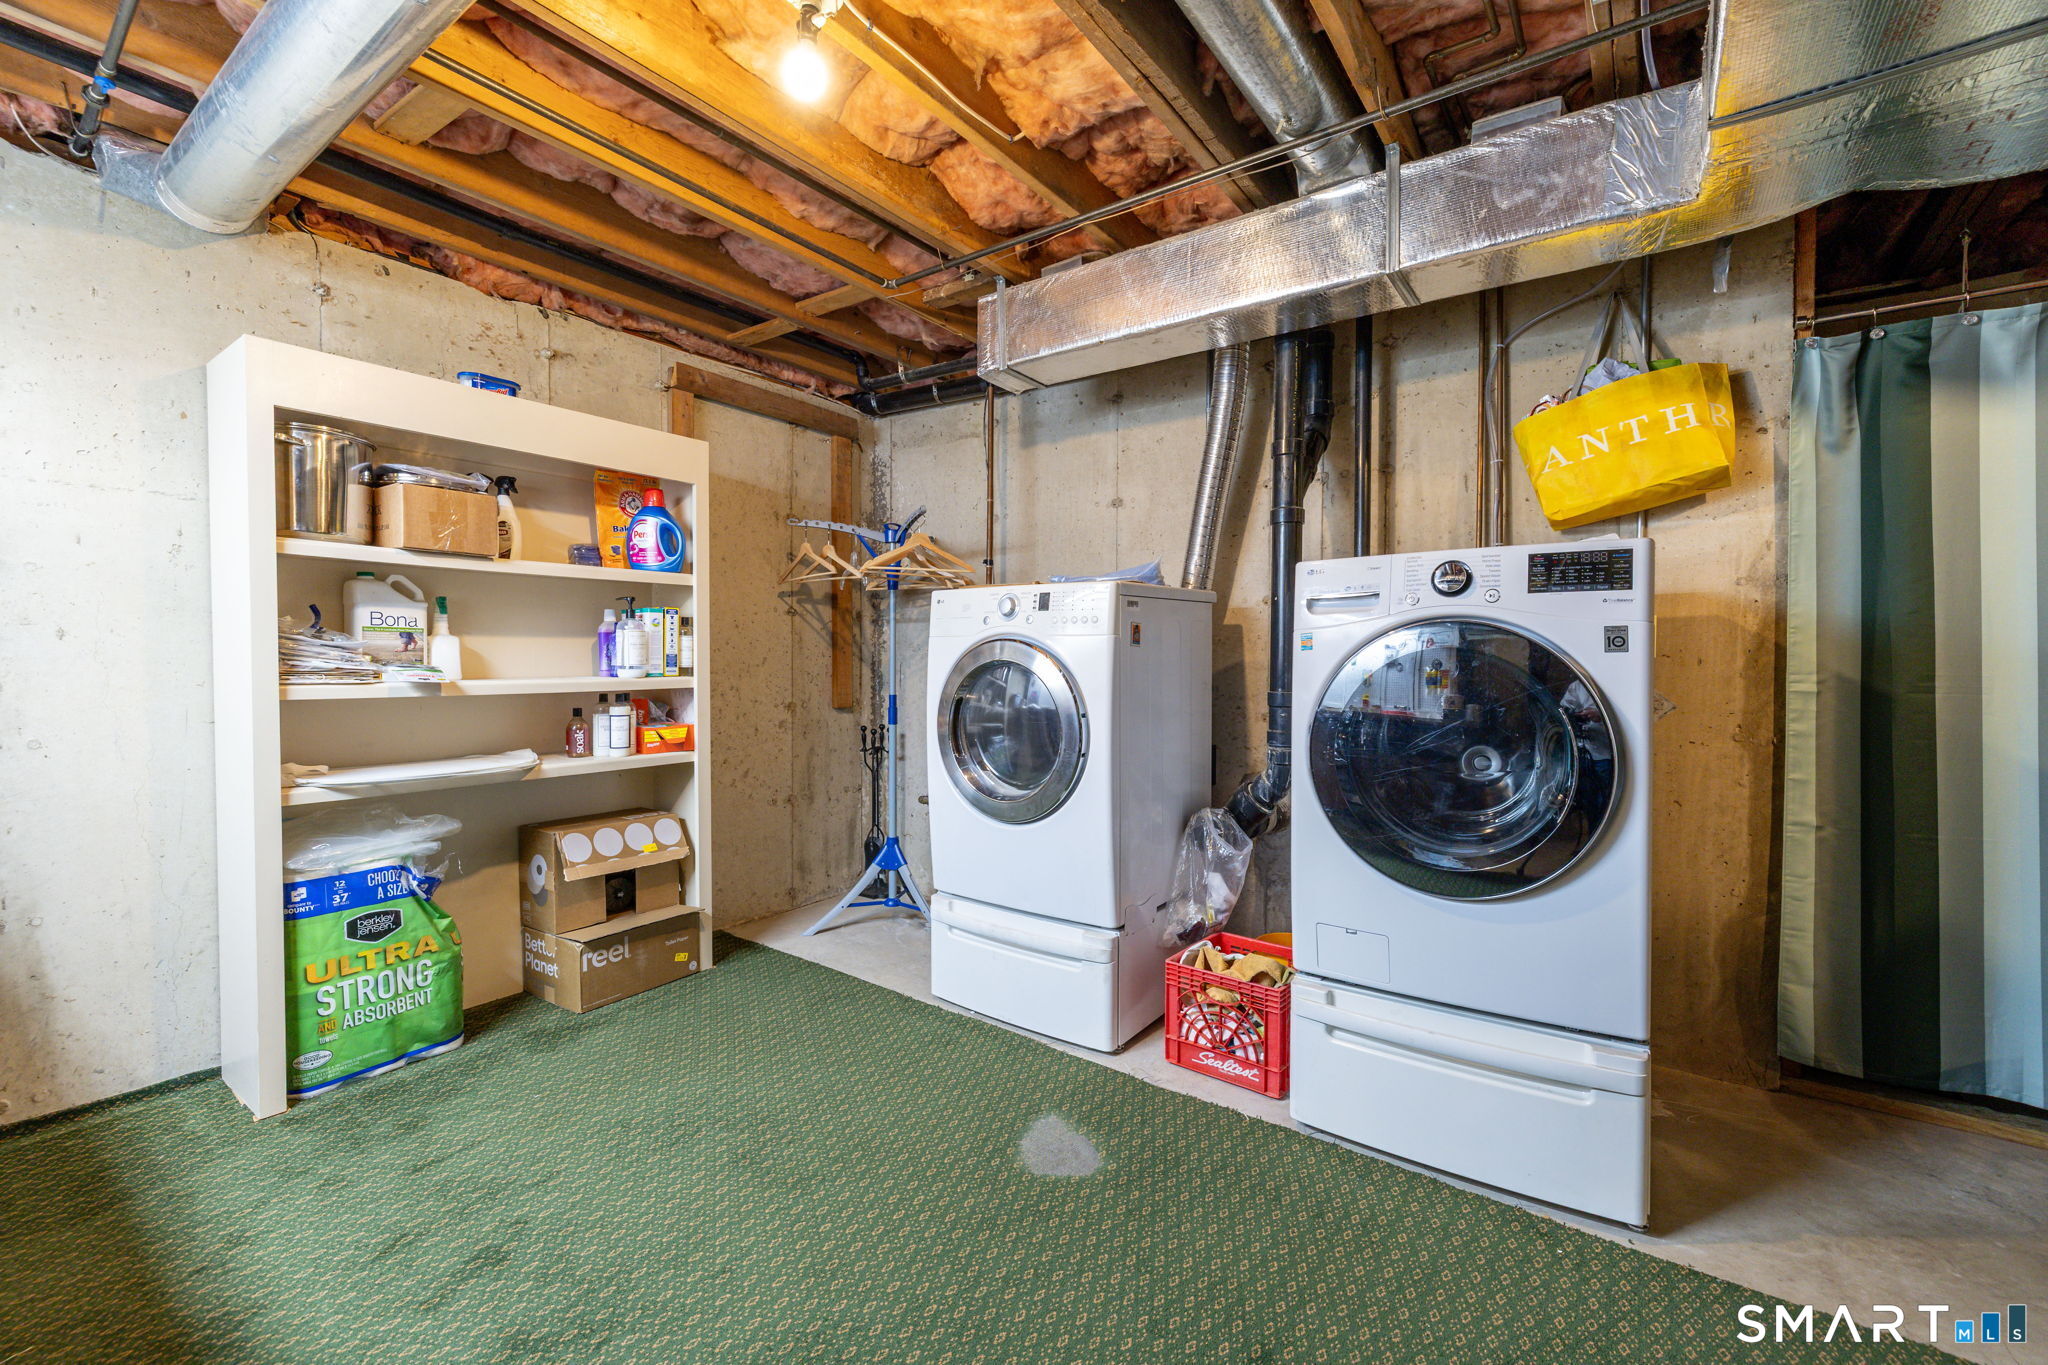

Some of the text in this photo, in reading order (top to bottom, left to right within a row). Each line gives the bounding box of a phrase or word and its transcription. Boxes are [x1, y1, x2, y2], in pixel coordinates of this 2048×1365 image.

[612, 525, 629, 533] Bak
[370, 611, 419, 627] Bona
[1606, 635, 1626, 648] 10
[377, 886, 385, 900] A
[284, 904, 315, 914] BOUNTY
[357, 914, 395, 928] berkley
[305, 934, 440, 984] ULTRA
[582, 935, 629, 973] reel
[525, 952, 559, 979] Planet
[316, 959, 433, 1016] STRONG
[317, 987, 432, 1033] AND ABSORBENT
[1192, 1051, 1260, 1082] Sealtest
